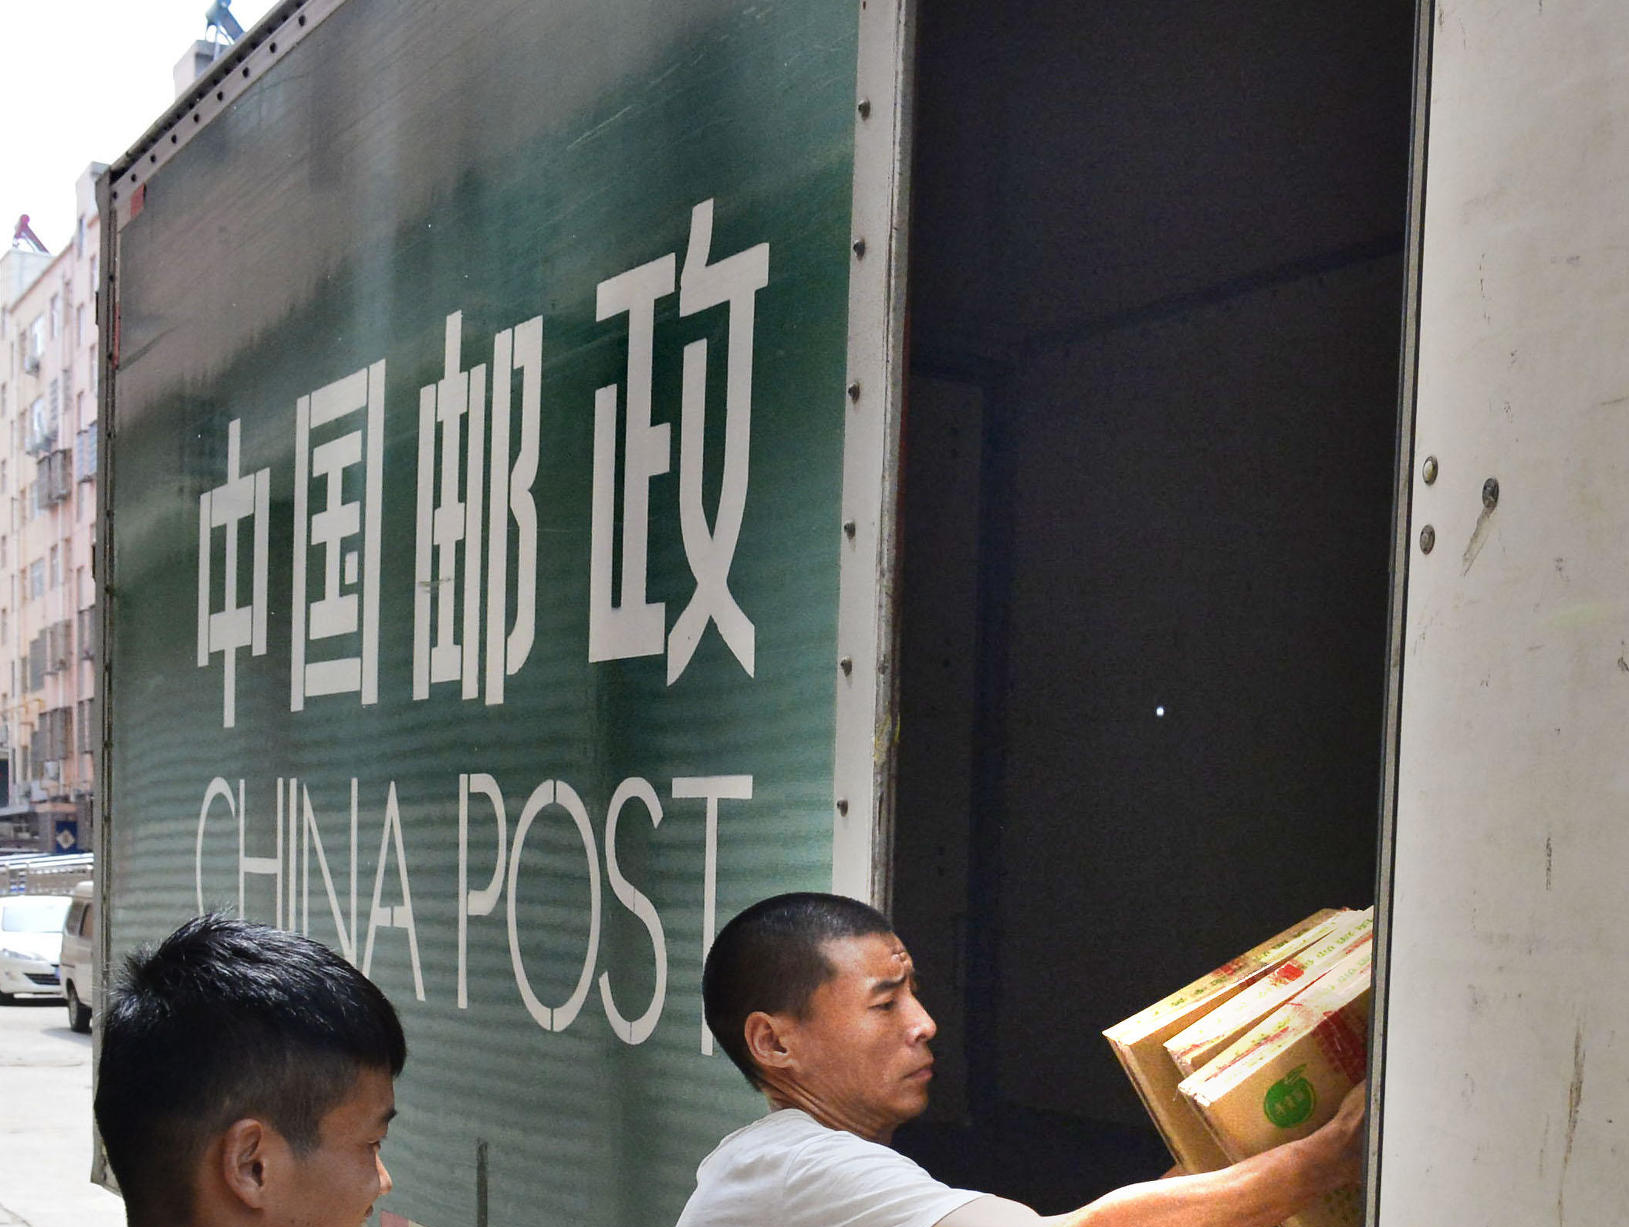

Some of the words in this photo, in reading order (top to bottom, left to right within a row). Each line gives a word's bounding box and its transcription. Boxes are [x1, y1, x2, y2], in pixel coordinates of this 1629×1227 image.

[197, 198, 770, 728] 中国邮政
[196, 776, 426, 1002] CHINA
[457, 773, 753, 1057] POST
